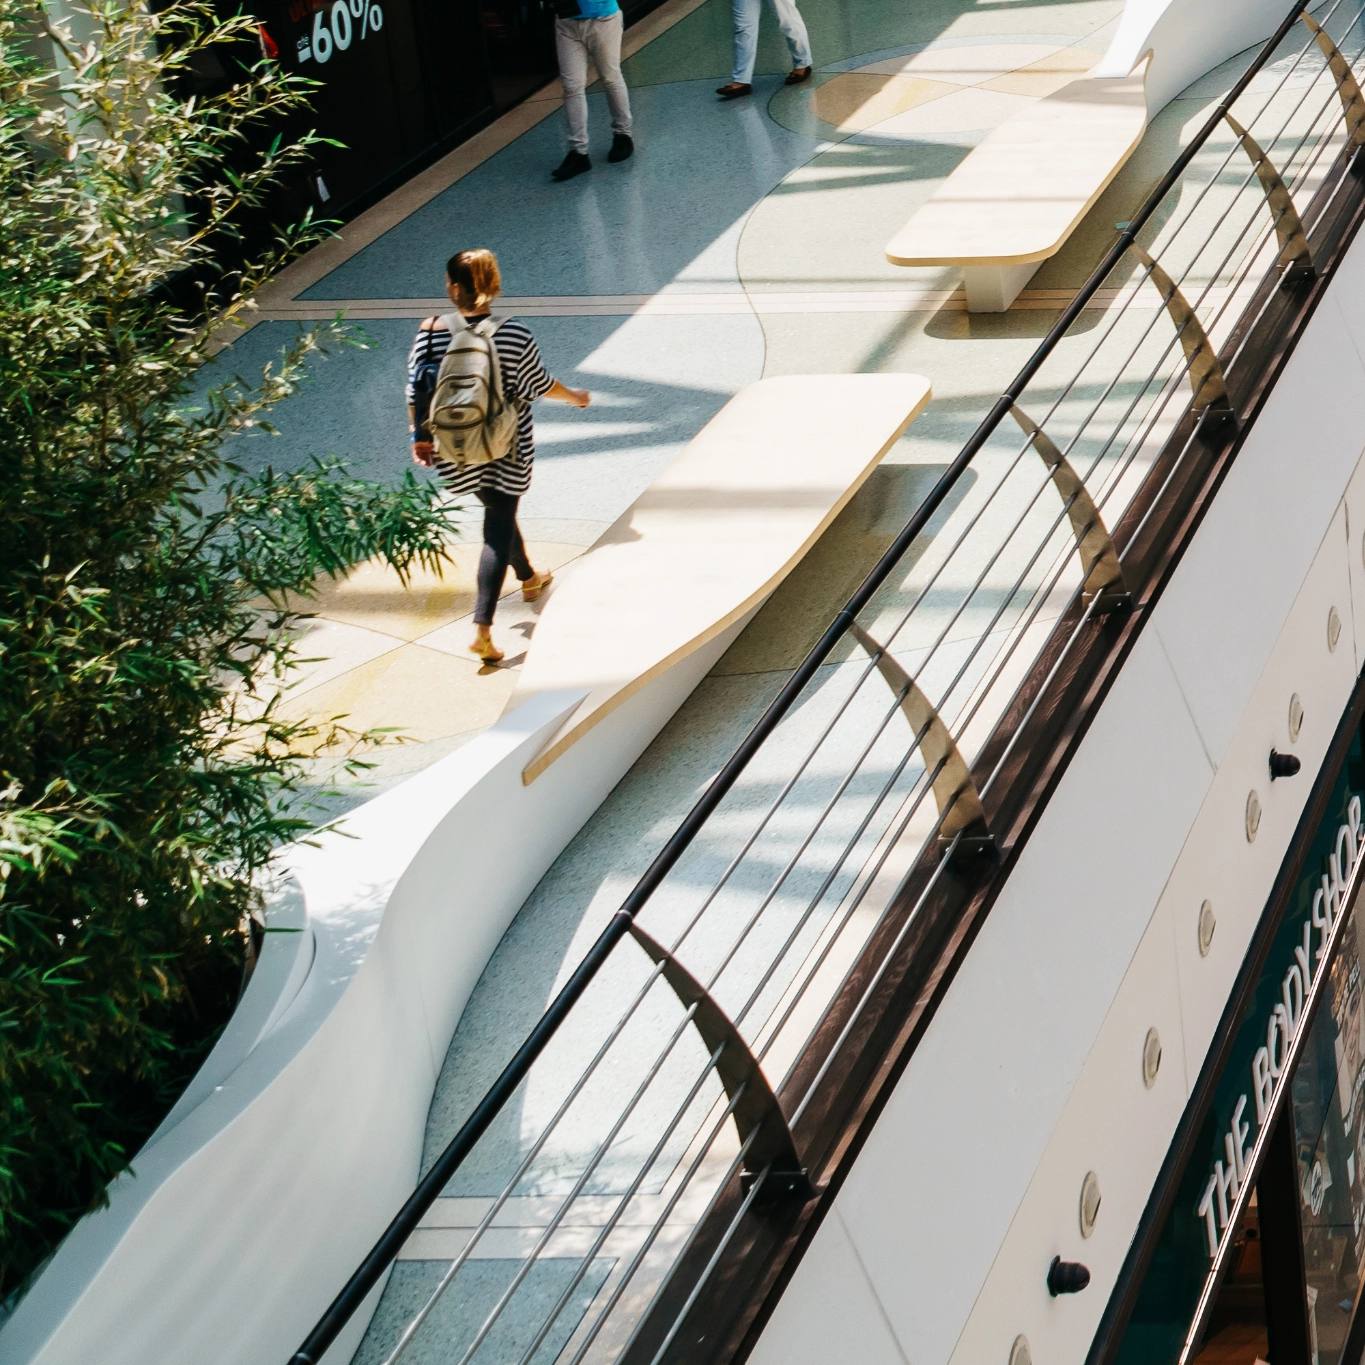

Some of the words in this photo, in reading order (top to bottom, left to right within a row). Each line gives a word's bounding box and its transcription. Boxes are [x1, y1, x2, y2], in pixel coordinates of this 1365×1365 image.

[1199, 1094, 1254, 1257] THE
[1252, 920, 1313, 1125] BODY
[1313, 795, 1365, 958] SHOP
